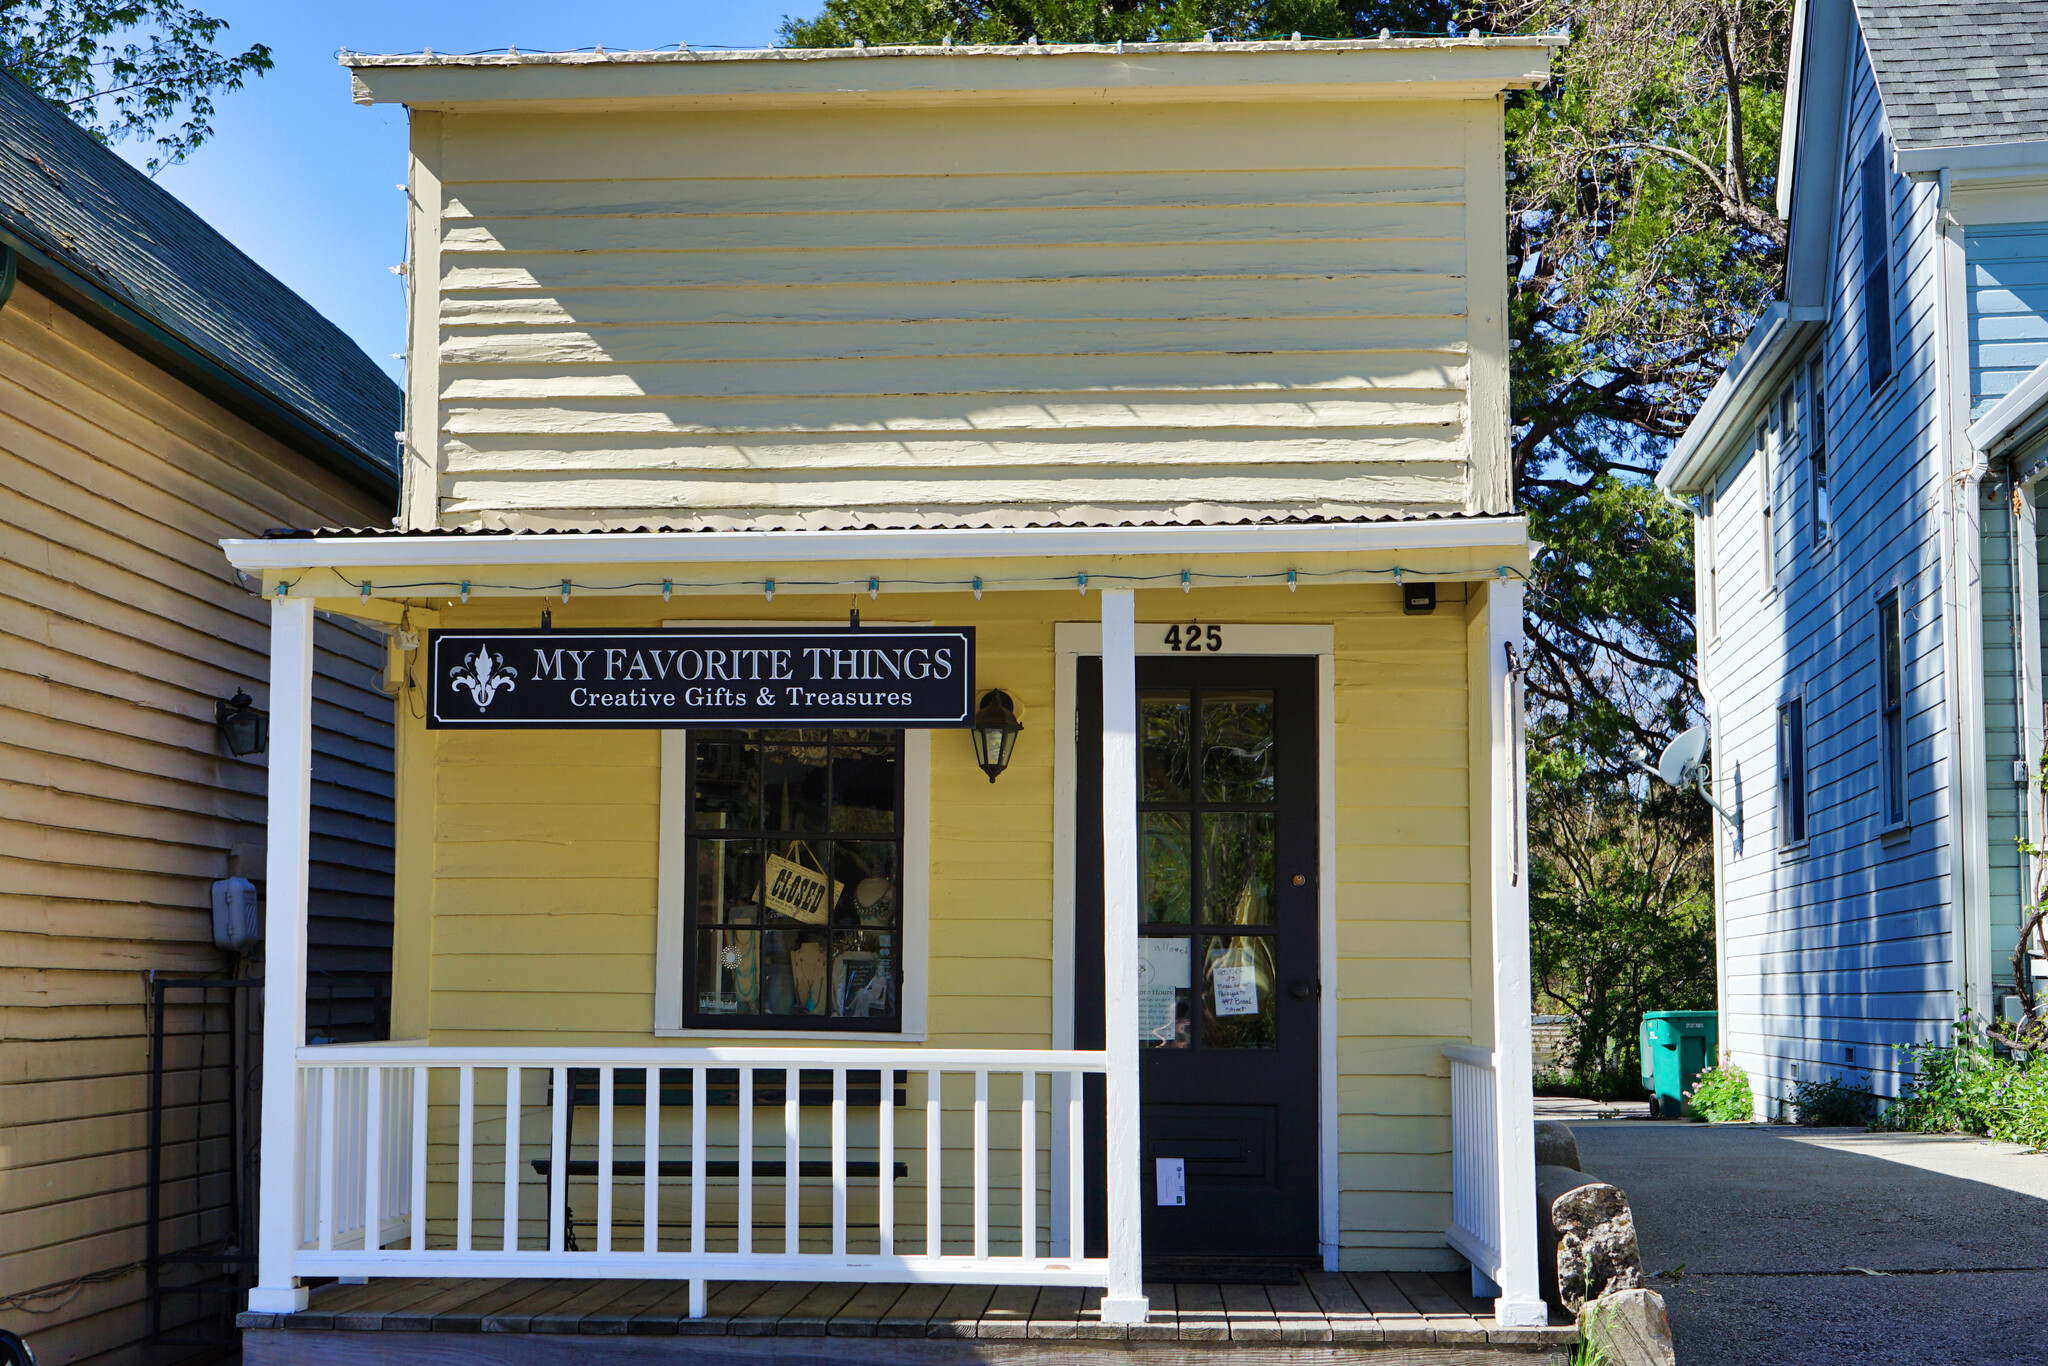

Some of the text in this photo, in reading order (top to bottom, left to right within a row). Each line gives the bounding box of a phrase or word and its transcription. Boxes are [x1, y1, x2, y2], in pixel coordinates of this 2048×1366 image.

[1164, 624, 1223, 652] 425
[531, 648, 952, 681] MY FAVORITE THINGS
[570, 686, 912, 707] Creative Gifts & Treasures
[771, 868, 826, 914] CLOSED
[1154, 941, 1188, 955] allowed
